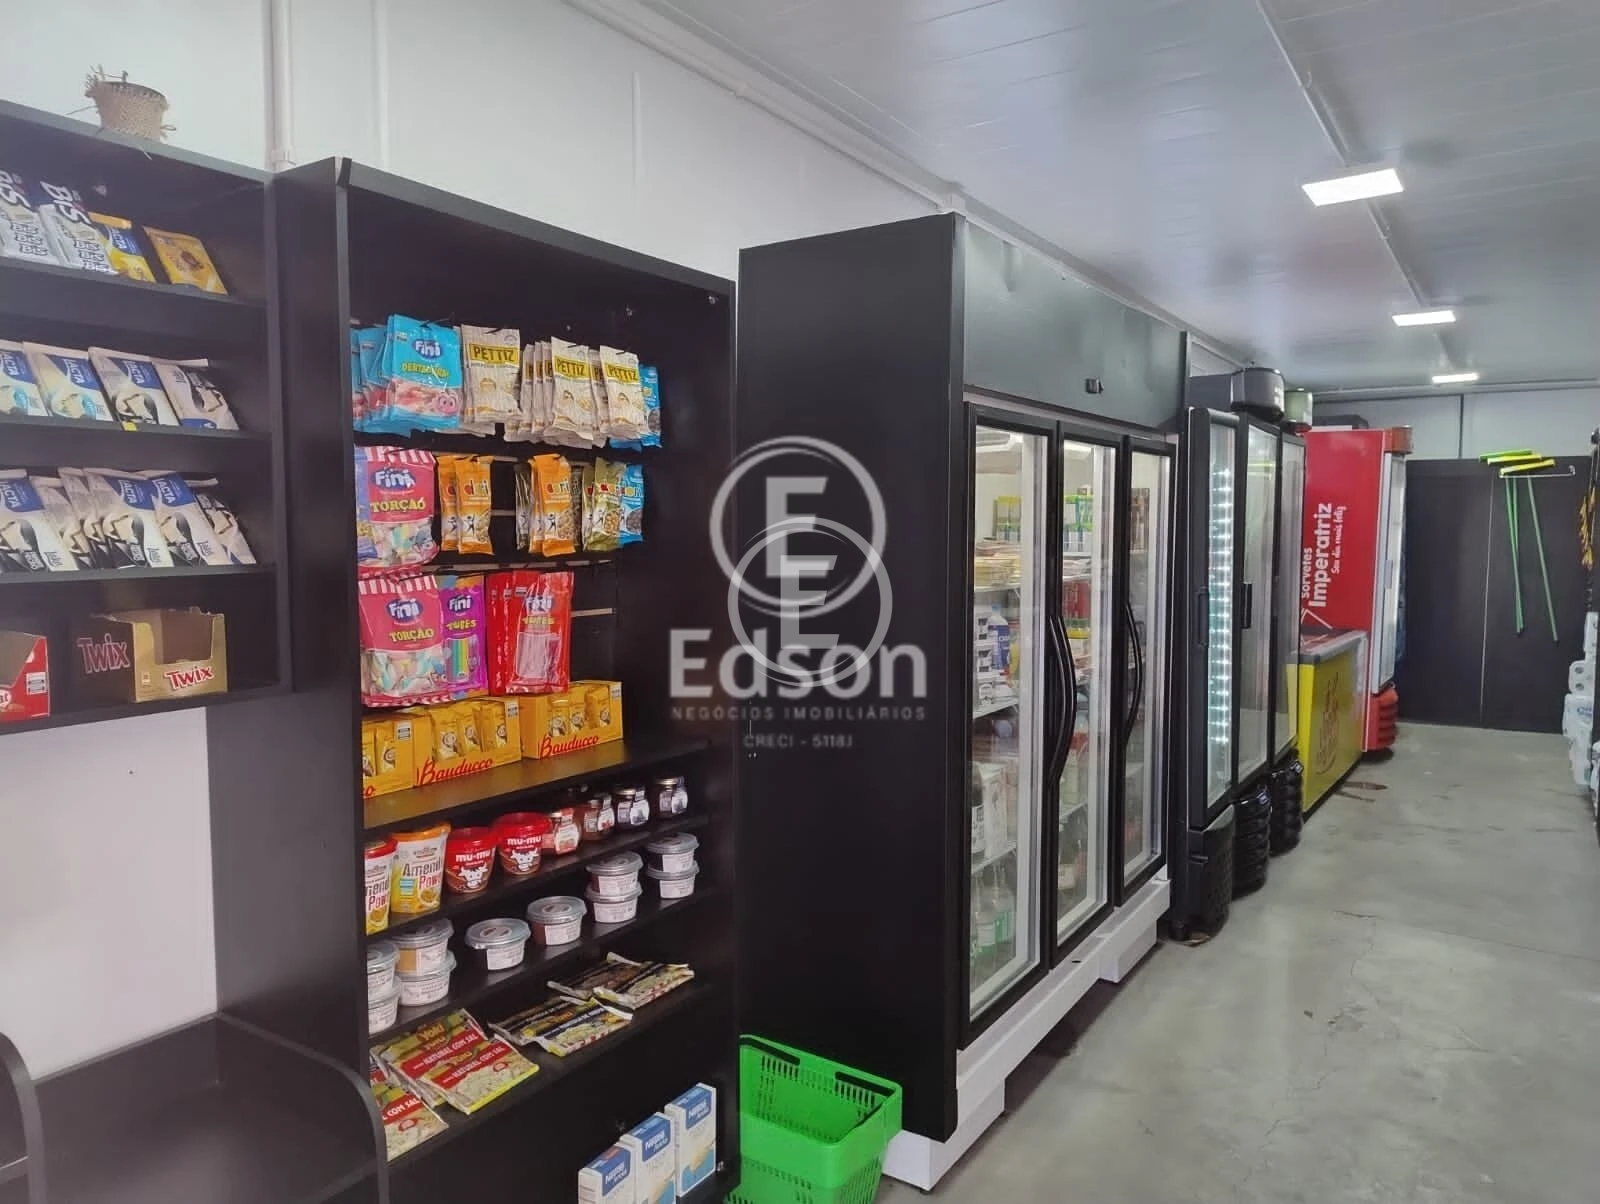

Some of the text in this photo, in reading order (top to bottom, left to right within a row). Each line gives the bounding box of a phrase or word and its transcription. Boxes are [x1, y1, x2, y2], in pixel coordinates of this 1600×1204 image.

[40, 181, 92, 225] BIS
[415, 340, 441, 358] Fini
[473, 346, 514, 361] PETTIZ
[556, 359, 585, 376] PETTIZ
[607, 364, 637, 380] PETTIZ
[375, 469, 415, 488] Fini
[152, 479, 176, 504] LACTA
[1308, 503, 1332, 608] Imperatriz
[389, 598, 420, 619] Fini
[449, 594, 472, 611] Fini
[76, 633, 131, 674] Twix
[163, 665, 215, 692] Twix
[538, 734, 600, 759] Bauducco
[417, 758, 493, 786] Bauducco
[508, 835, 541, 847] mu-mu
[455, 849, 490, 863] mu-mu
[387, 1103, 405, 1118] COM
[405, 1097, 420, 1110] SAL
